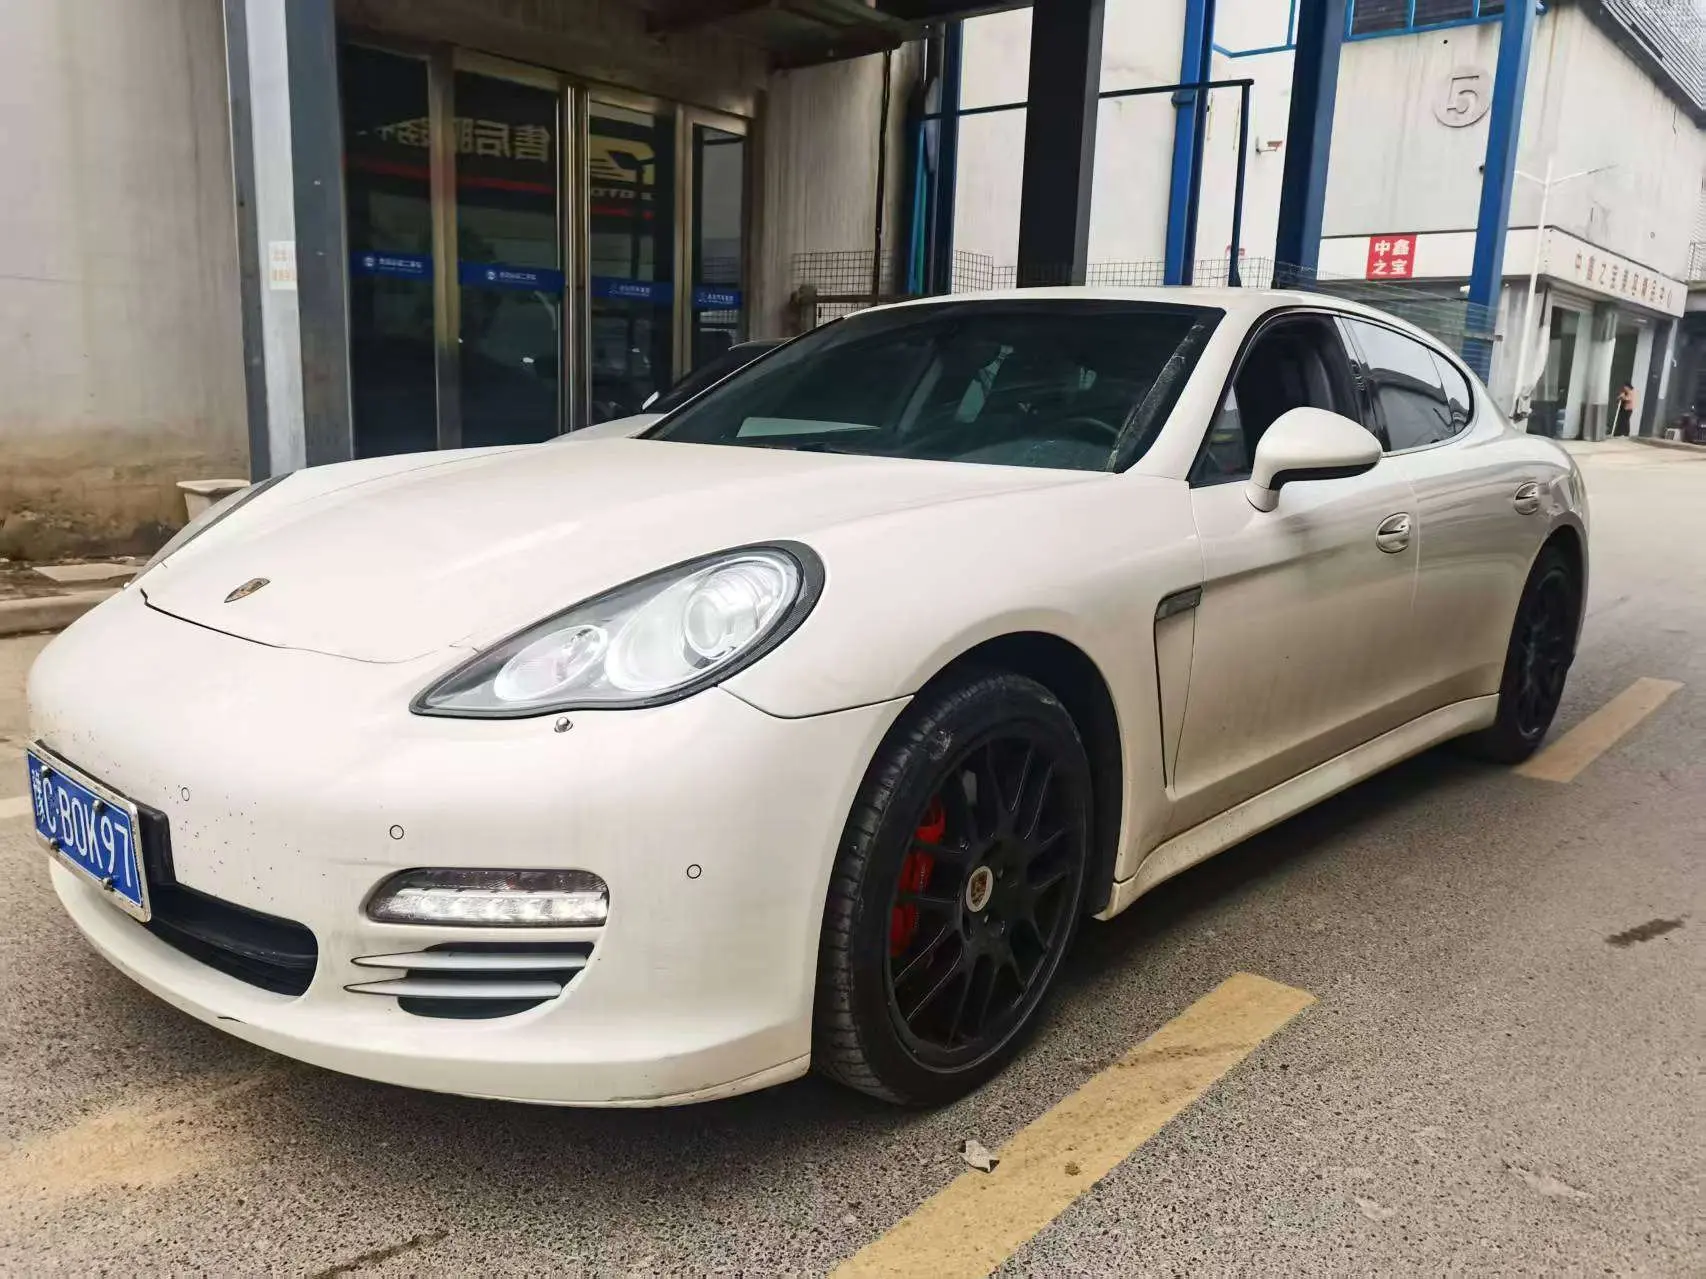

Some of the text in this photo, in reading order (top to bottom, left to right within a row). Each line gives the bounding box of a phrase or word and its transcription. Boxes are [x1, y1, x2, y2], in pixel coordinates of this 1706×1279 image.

[1446, 74, 1480, 118] 5
[1374, 238, 1410, 256] 中鑫
[1371, 258, 1408, 275] 之宝
